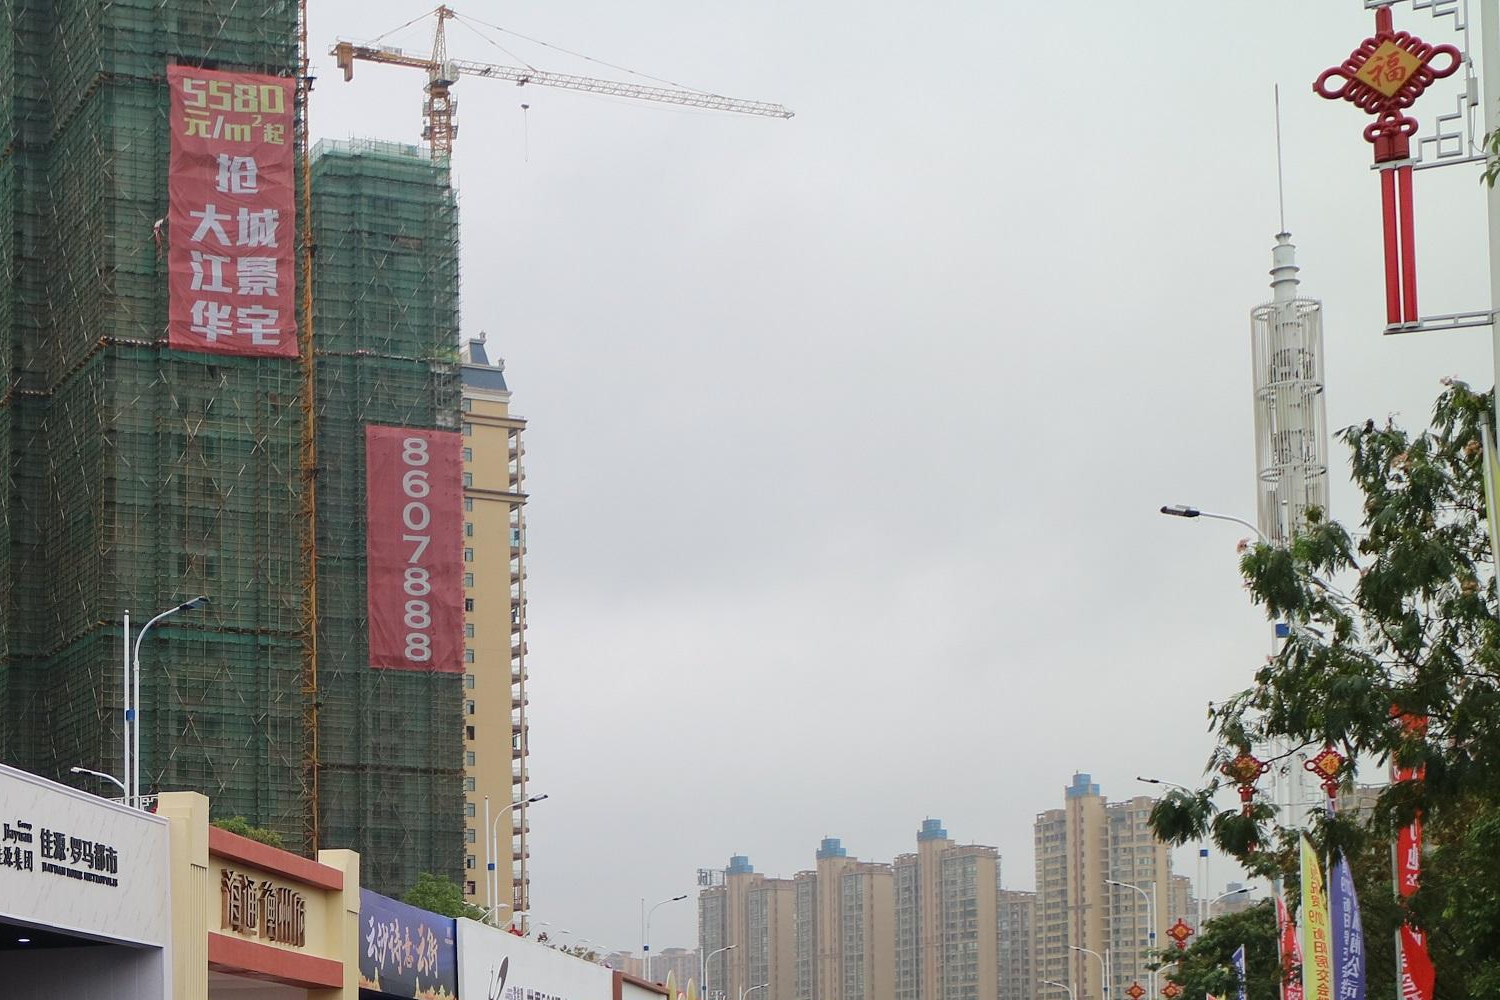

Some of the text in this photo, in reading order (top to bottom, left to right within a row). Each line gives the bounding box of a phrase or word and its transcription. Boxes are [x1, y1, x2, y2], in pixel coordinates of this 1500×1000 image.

[1366, 52, 1406, 88] 福
[183, 78, 285, 116] 5580
[214, 153, 259, 195] 抢
[189, 204, 279, 249] 大城
[190, 250, 279, 297] 江景
[190, 300, 280, 346] 华宅
[401, 437, 432, 662] 8607888
